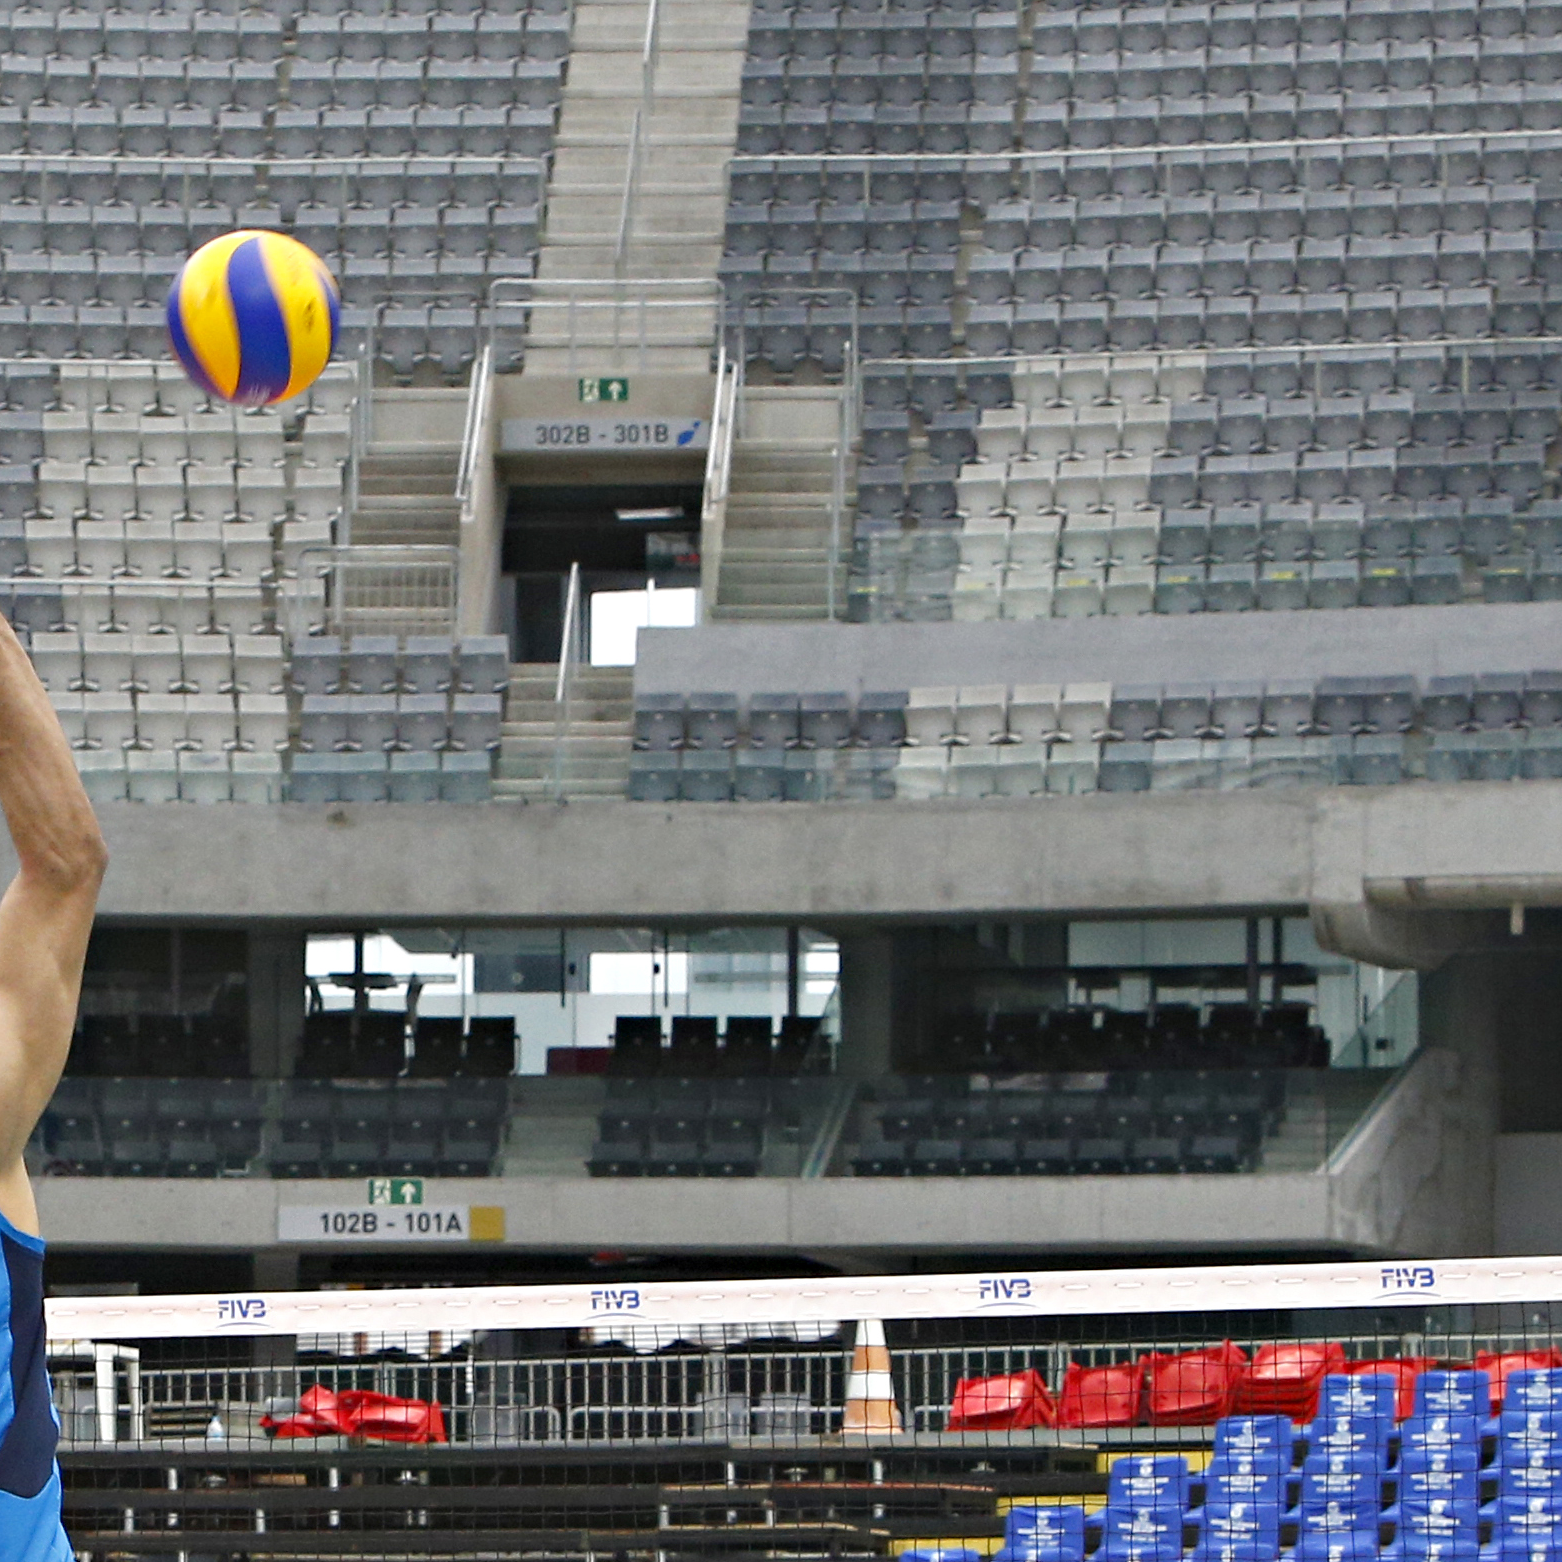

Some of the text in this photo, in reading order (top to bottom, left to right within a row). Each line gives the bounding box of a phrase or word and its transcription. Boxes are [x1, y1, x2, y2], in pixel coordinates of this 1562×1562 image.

[535, 425, 590, 445] 302B
[614, 424, 669, 444] 301B
[320, 1212, 378, 1234] 102B
[405, 1212, 462, 1233] 101A
[1380, 1267, 1436, 1288] FIVB
[590, 1289, 640, 1310] FIVB
[978, 1279, 1032, 1299] FIVB
[217, 1298, 266, 1319] FIVB
